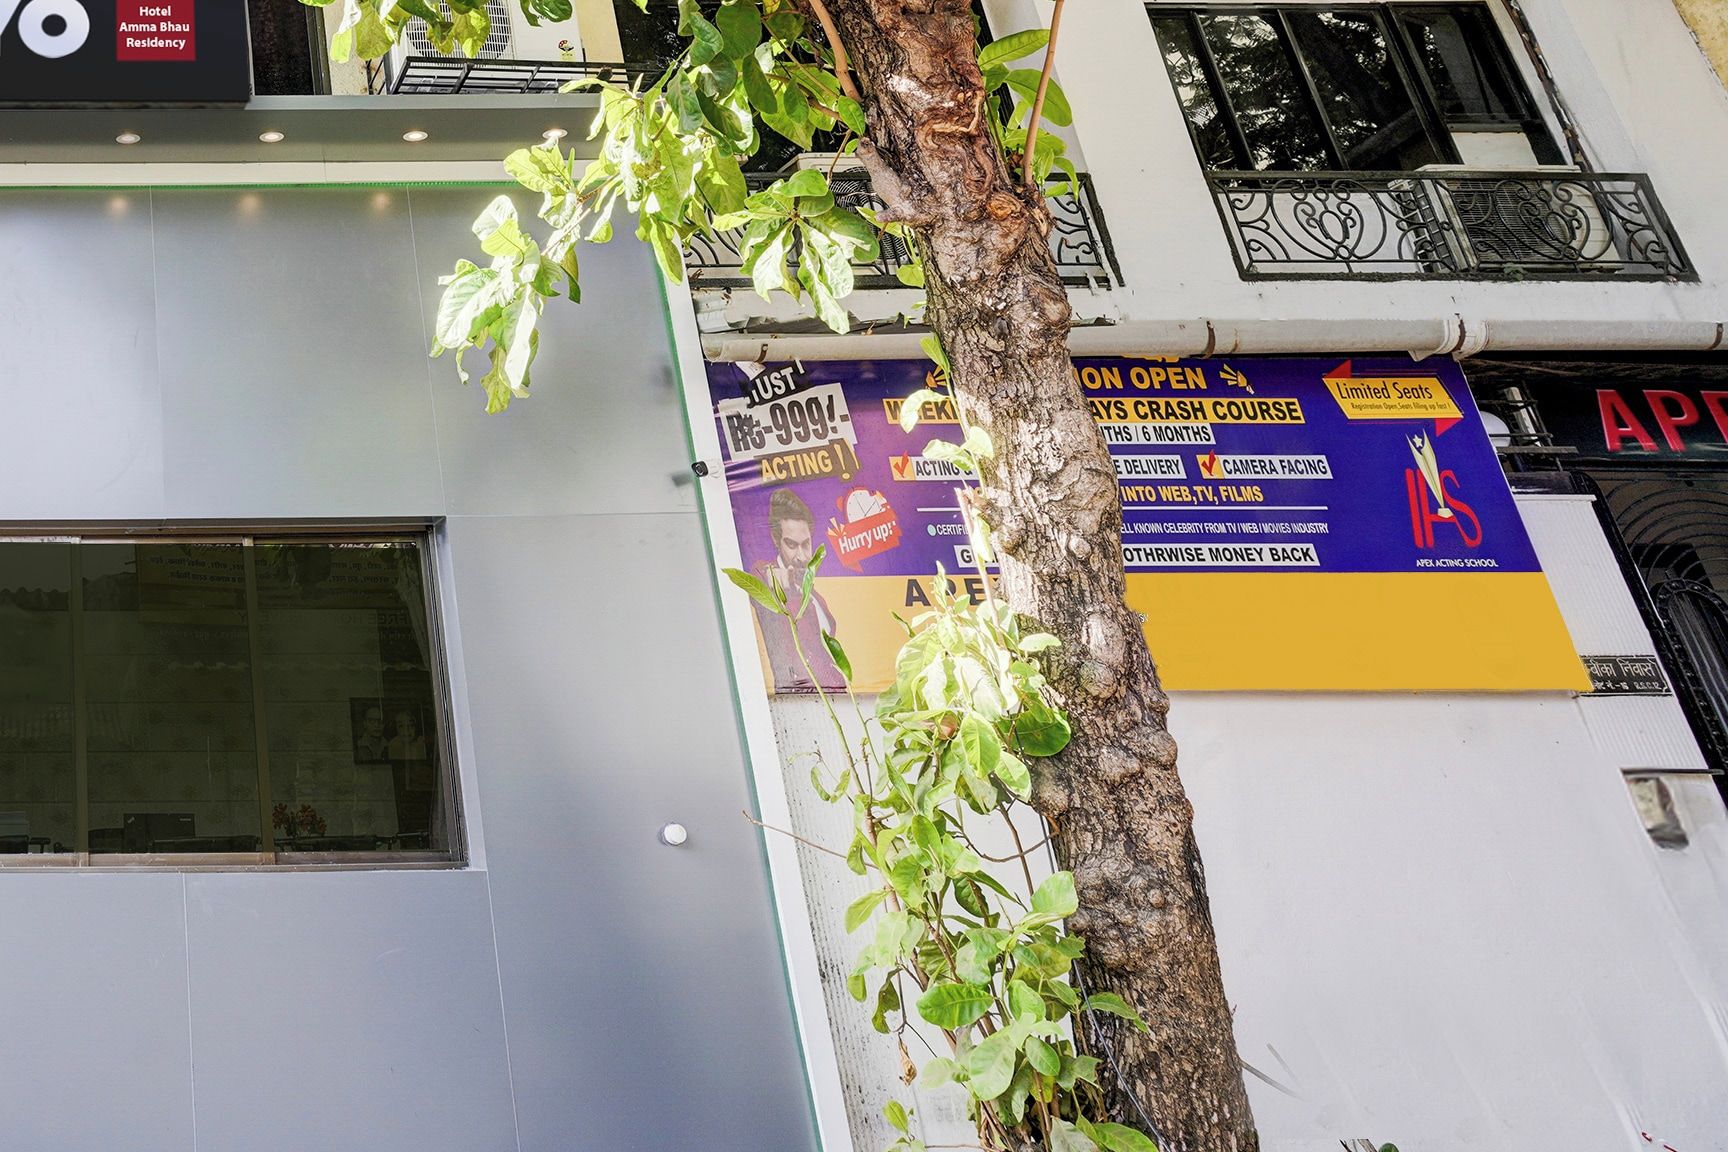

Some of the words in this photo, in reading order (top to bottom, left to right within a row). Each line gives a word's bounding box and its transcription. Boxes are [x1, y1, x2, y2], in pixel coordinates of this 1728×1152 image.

[139, 5, 171, 16] Hotel
[119, 21, 157, 32] Amma
[159, 21, 190, 32] Bhau
[126, 36, 186, 50] Residency
[1129, 366, 1208, 390] OPEN
[1336, 381, 1391, 400] Limited
[1392, 382, 1433, 400] Seats
[1133, 400, 1208, 421] CRASH
[1212, 400, 1302, 421] COURSE
[1142, 425, 1150, 442] 6
[1154, 425, 1211, 442] MONTHS
[761, 449, 833, 482] ACTING
[915, 460, 960, 476] ACTING
[1124, 459, 1182, 475] DELIVERY
[1224, 458, 1278, 475] CAMERA
[1280, 458, 1328, 475] FACING
[1120, 485, 1157, 502] INTO
[1219, 485, 1265, 502] FILMS
[1134, 522, 1163, 534] KNOWN
[1163, 522, 1204, 534] CELEBRITY
[1204, 522, 1226, 534] FROM
[1226, 522, 1238, 534] TV
[1242, 522, 1259, 534] WEB
[1263, 522, 1291, 534] MOVIES
[1291, 522, 1329, 534] INDUSTRY
[838, 529, 872, 555] Hurry
[1123, 547, 1205, 563] OTHRWISE
[1209, 547, 1264, 563] MONEY
[1272, 547, 1315, 563] BACK
[1435, 558, 1465, 567] ACTING
[1464, 558, 1499, 567] SCHOOL
